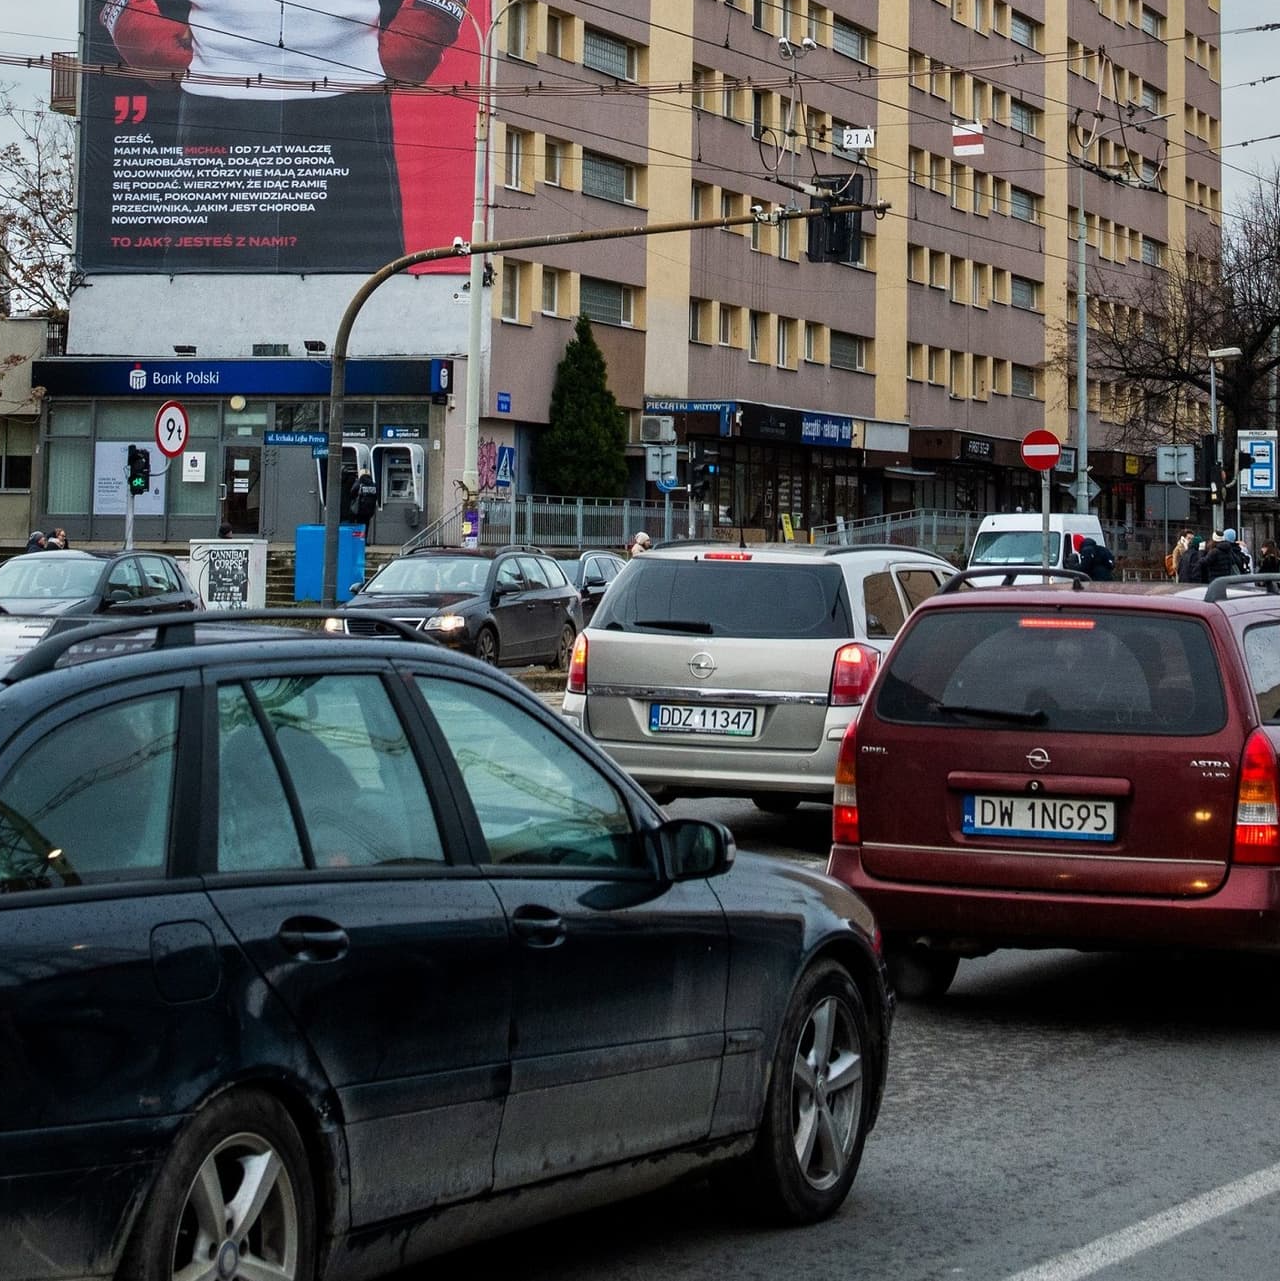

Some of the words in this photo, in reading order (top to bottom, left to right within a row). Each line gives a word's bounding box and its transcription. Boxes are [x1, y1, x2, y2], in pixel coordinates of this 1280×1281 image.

[114, 133, 154, 145] CZEŚĆ,
[846, 133, 859, 145] 21
[865, 133, 872, 145] A
[114, 147, 140, 155] MAM
[142, 147, 159, 155] NA
[160, 147, 183, 156] IMIĘ
[184, 146, 228, 155] MICHAŁ
[229, 146, 233, 154] I
[234, 146, 252, 154] OD
[253, 145, 261, 154] 7
[262, 145, 283, 154] LAT
[284, 144, 332, 155] WALCZĘ
[113, 159, 121, 167] Z
[123, 158, 226, 168] NAUROBLASTOMĄ.
[228, 157, 274, 167] DOŁĄCZ
[275, 157, 292, 165] DO
[294, 156, 335, 165] GRONA
[113, 168, 195, 178] WOJOWNIKÓW,
[196, 167, 242, 177] KTÓRZY
[243, 168, 262, 177] NIE
[264, 168, 296, 179] MAJĄ
[297, 168, 349, 177] ZAMIARU
[112, 181, 131, 191] SIĘ
[132, 179, 181, 190] PODDAĆ.
[183, 180, 245, 190] WIERZYMY,
[246, 179, 262, 189] ŻE
[263, 180, 290, 190] IDĄC
[291, 180, 327, 190] RAMIĘ
[112, 193, 123, 201] W
[124, 193, 163, 203] RAMIĘ,
[164, 192, 229, 201] POKONAMY
[230, 191, 328, 200] NIEWIDZIALNEGO
[112, 204, 192, 213] PRZECIWNIKA,
[193, 204, 228, 212] JAKIM
[229, 204, 258, 212] JEST
[259, 203, 316, 212] CHOROBA
[111, 216, 208, 224] NOWOTWOROWA!
[111, 236, 131, 247] TO
[133, 236, 172, 247] JAK?
[174, 233, 233, 247] JESTEŚ
[235, 236, 246, 247] Z
[249, 236, 297, 247] NAMI?
[153, 371, 182, 385] Bank
[186, 371, 220, 385] Polski
[210, 550, 248, 561] CANNIBAL
[214, 560, 243, 570] CORPSE
[660, 707, 694, 727] DDZ
[700, 709, 753, 730] 11347
[1190, 760, 1230, 768] ASTRA
[964, 815, 974, 823] PL
[981, 799, 1014, 827] DW
[1027, 802, 1108, 832] 1NG95
